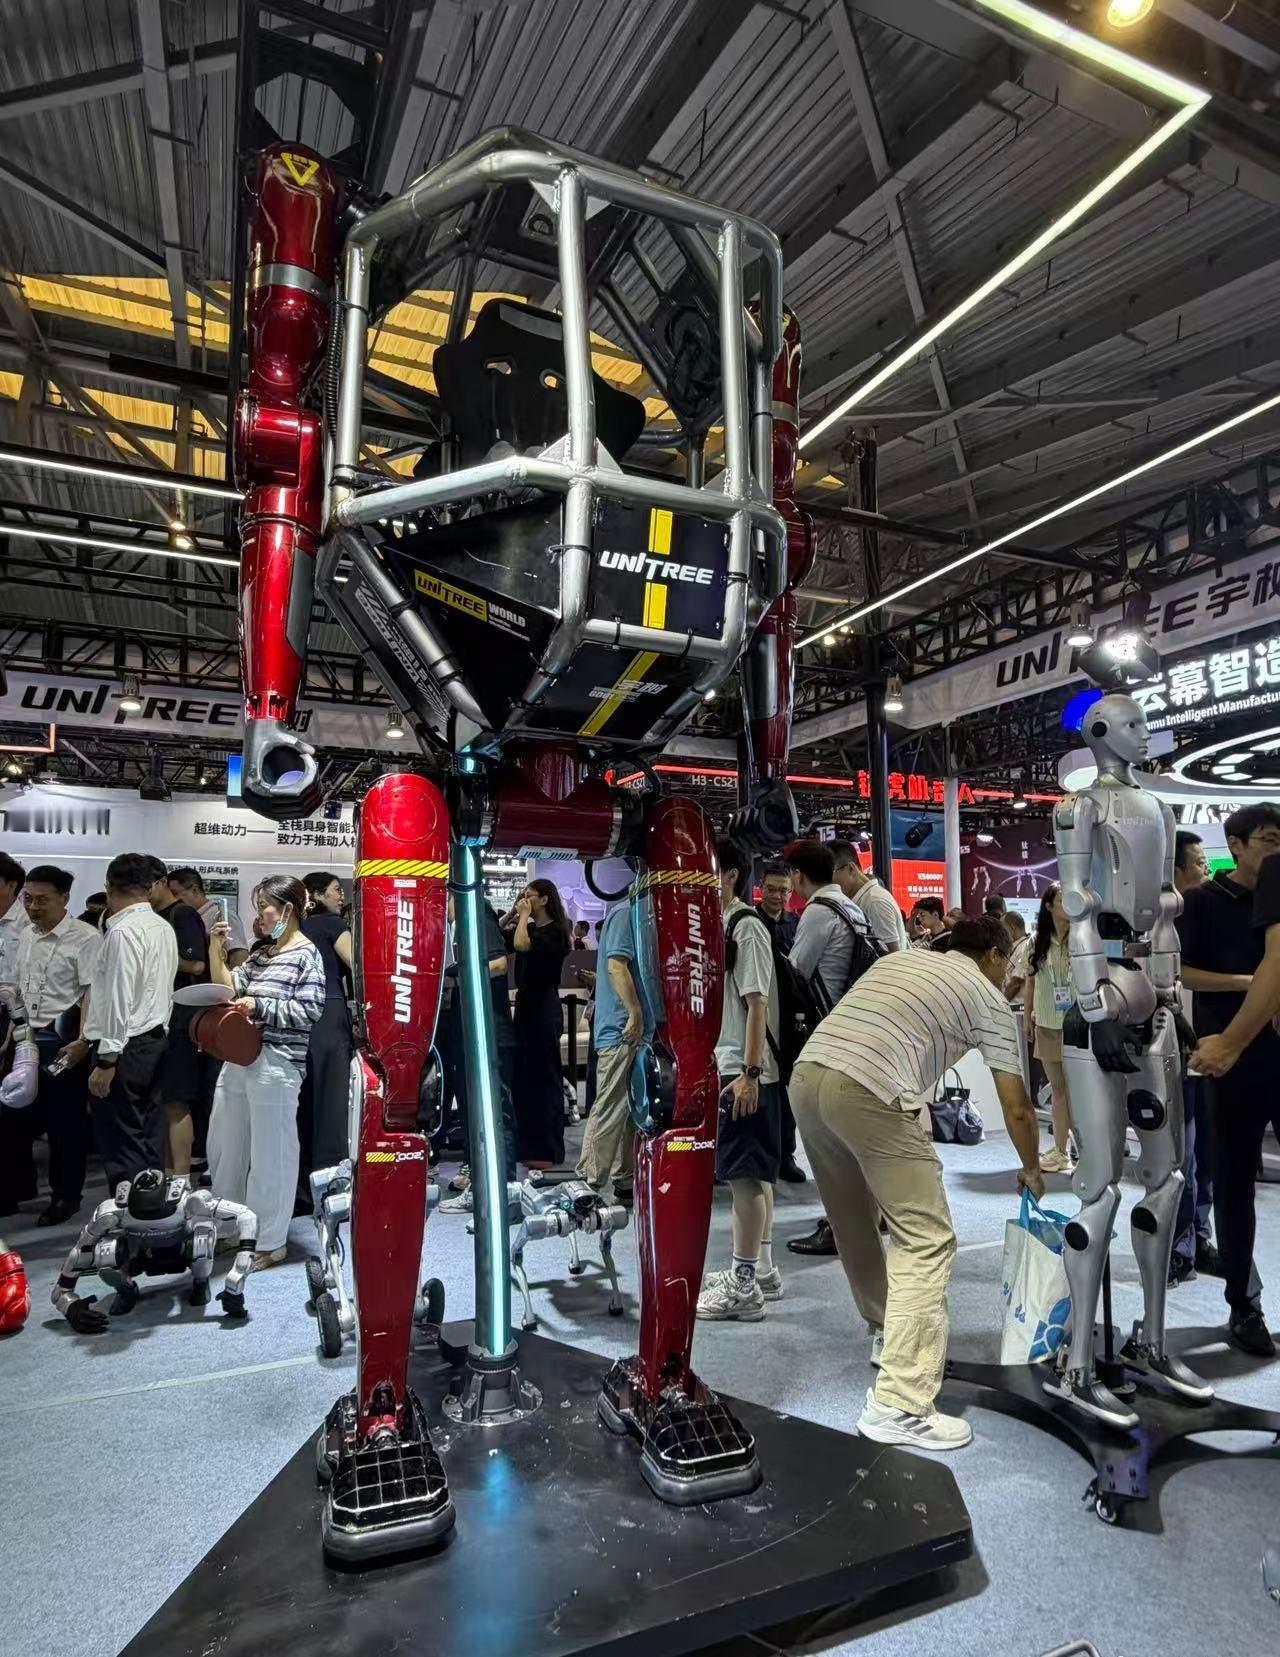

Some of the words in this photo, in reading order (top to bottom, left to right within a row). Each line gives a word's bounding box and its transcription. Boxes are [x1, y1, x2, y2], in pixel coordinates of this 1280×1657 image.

[600, 551, 714, 585] UNITREE
[418, 576, 485, 616] UNITREE
[488, 601, 526, 628] WORLD
[1166, 706, 1218, 726] Intelligent
[691, 774, 738, 788] H3-C521
[390, 898, 418, 1024] UNITREE
[684, 902, 706, 1019] UNITREE
